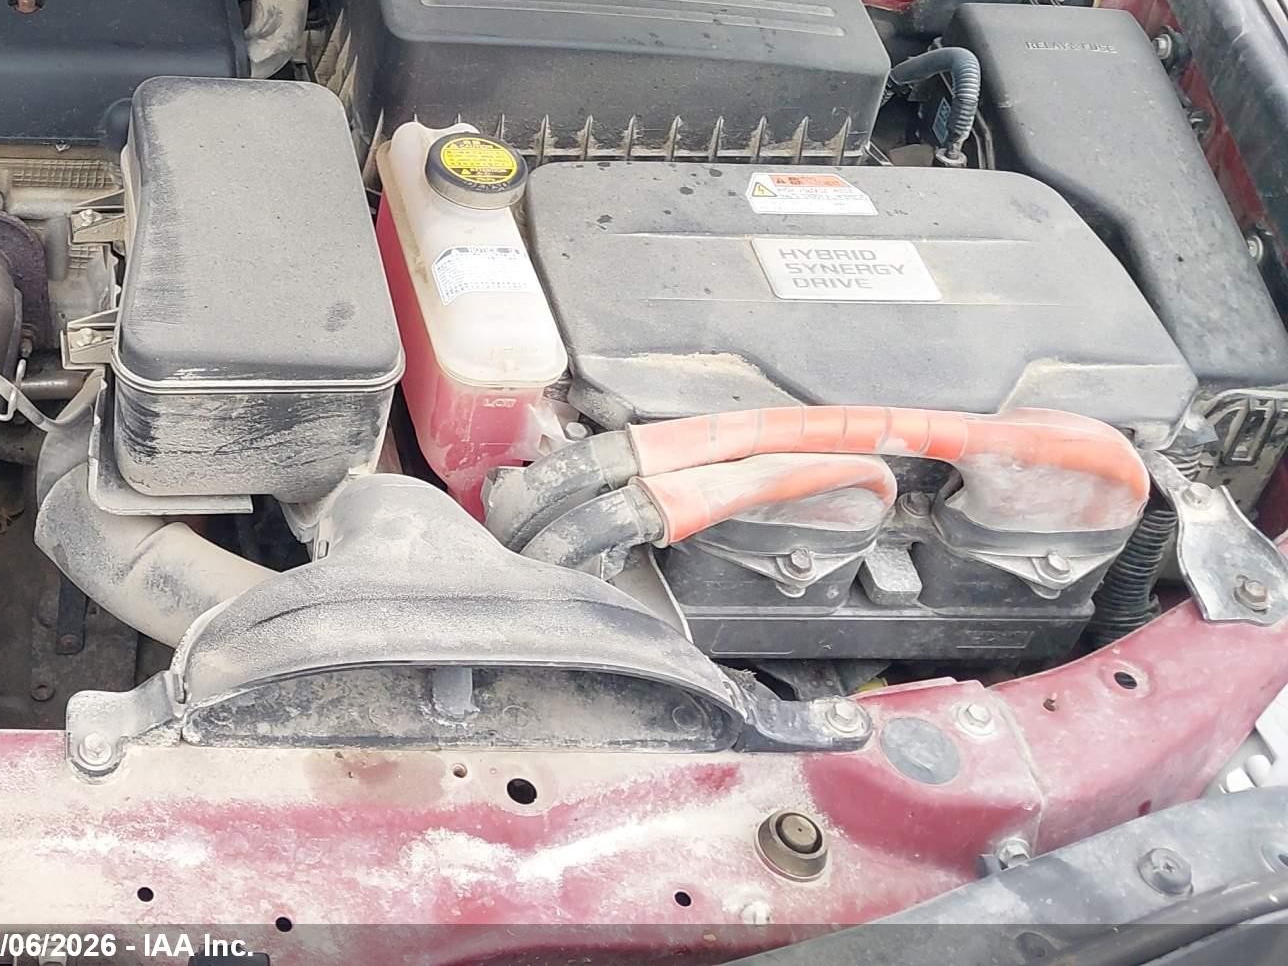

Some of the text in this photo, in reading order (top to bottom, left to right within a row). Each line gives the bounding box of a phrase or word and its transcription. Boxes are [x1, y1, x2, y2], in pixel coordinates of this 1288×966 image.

[777, 248, 877, 261] HYBRID
[784, 262, 905, 275] SYNERGY
[791, 277, 874, 289] DRIVE
